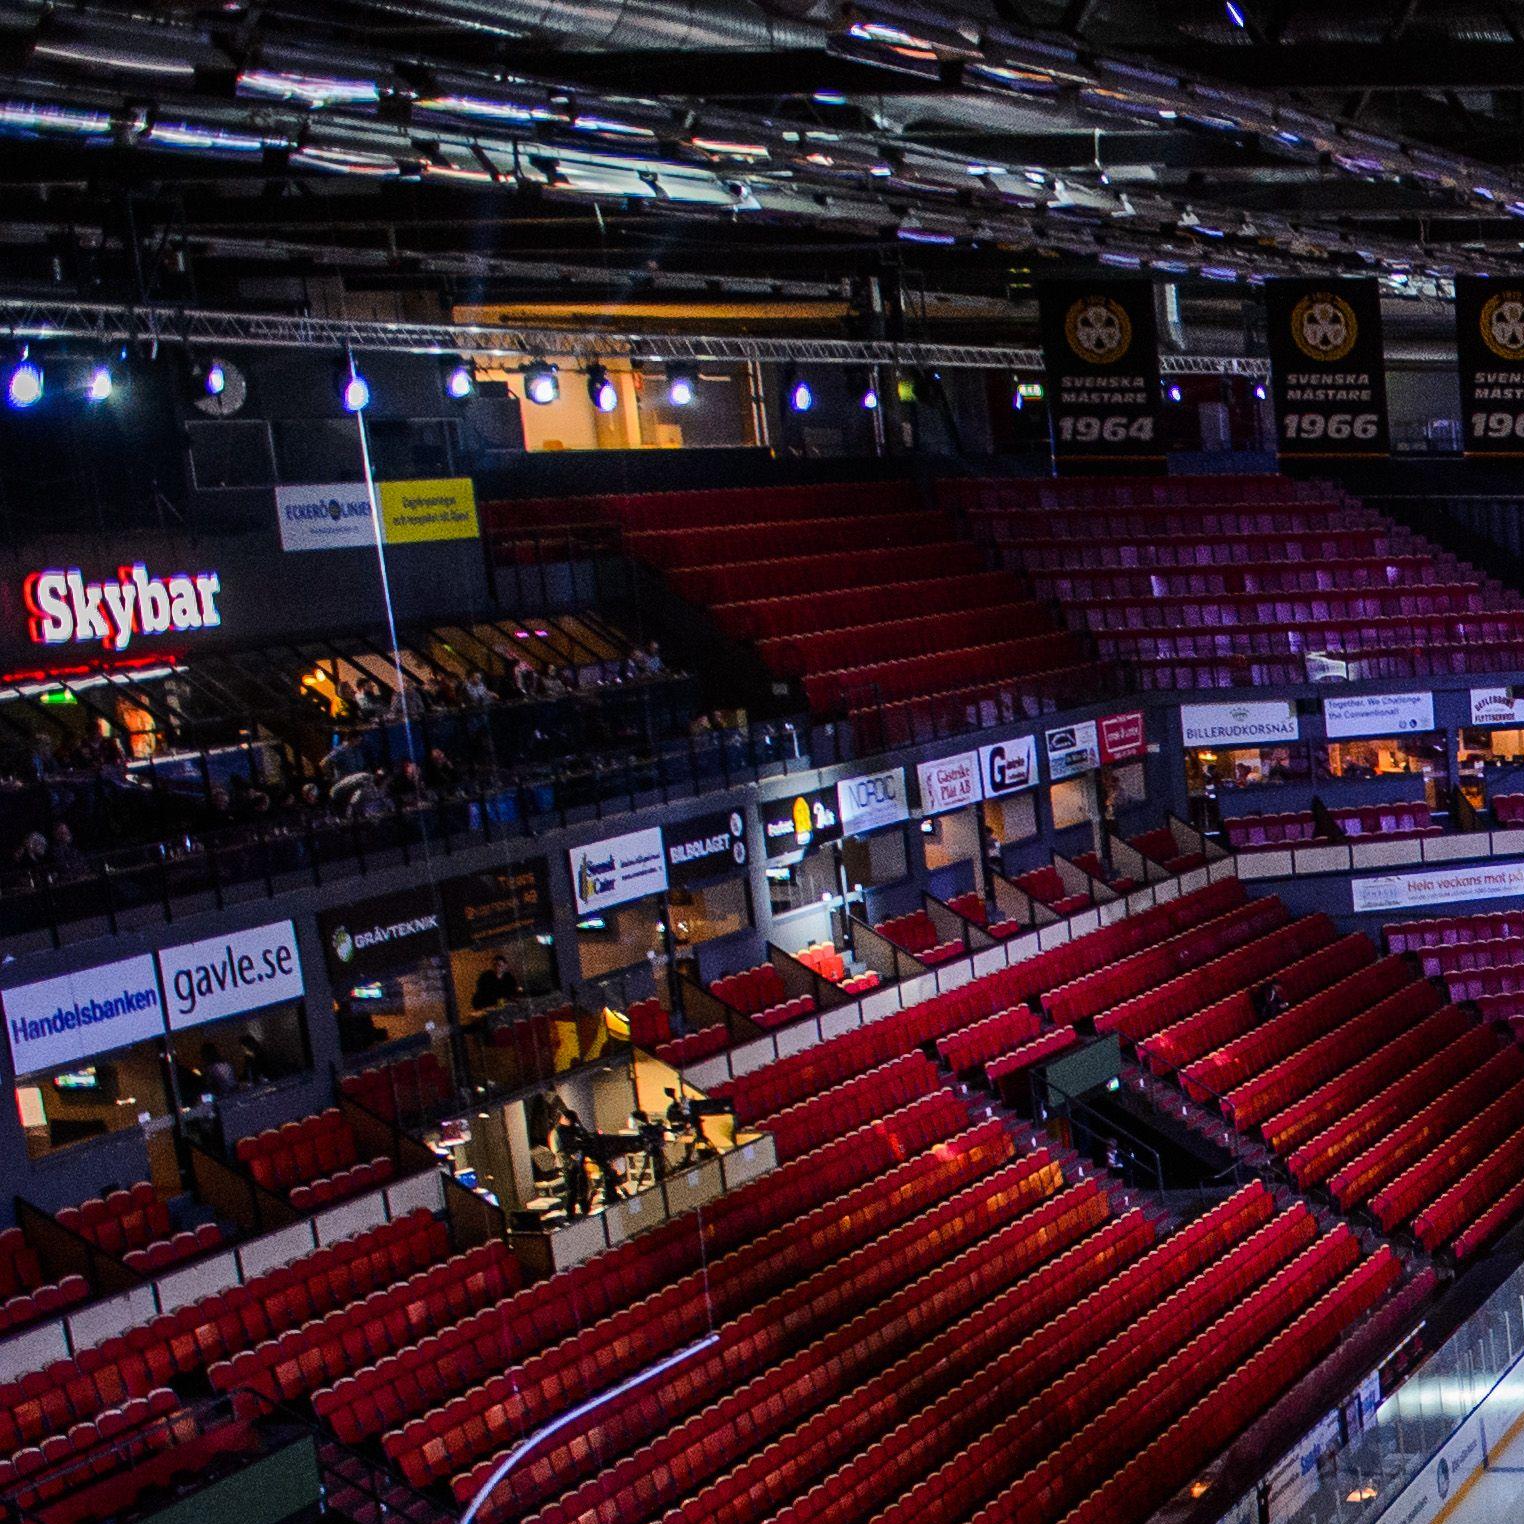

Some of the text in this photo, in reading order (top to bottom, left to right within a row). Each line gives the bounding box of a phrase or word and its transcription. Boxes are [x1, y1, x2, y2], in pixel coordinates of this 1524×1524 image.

[1060, 376, 1145, 388] SVENSKA
[1286, 374, 1370, 385] SVENSKA
[1058, 415, 1154, 442] 1964
[1282, 413, 1378, 439] 1966
[36, 562, 221, 650] Skybar
[1186, 721, 1296, 740] BILLERUDKORSNÄS
[1408, 880, 1435, 893] Hela
[1438, 875, 1482, 889] veckans
[174, 943, 294, 1015] gavle.se
[10, 984, 158, 1045] Handelsbanken
